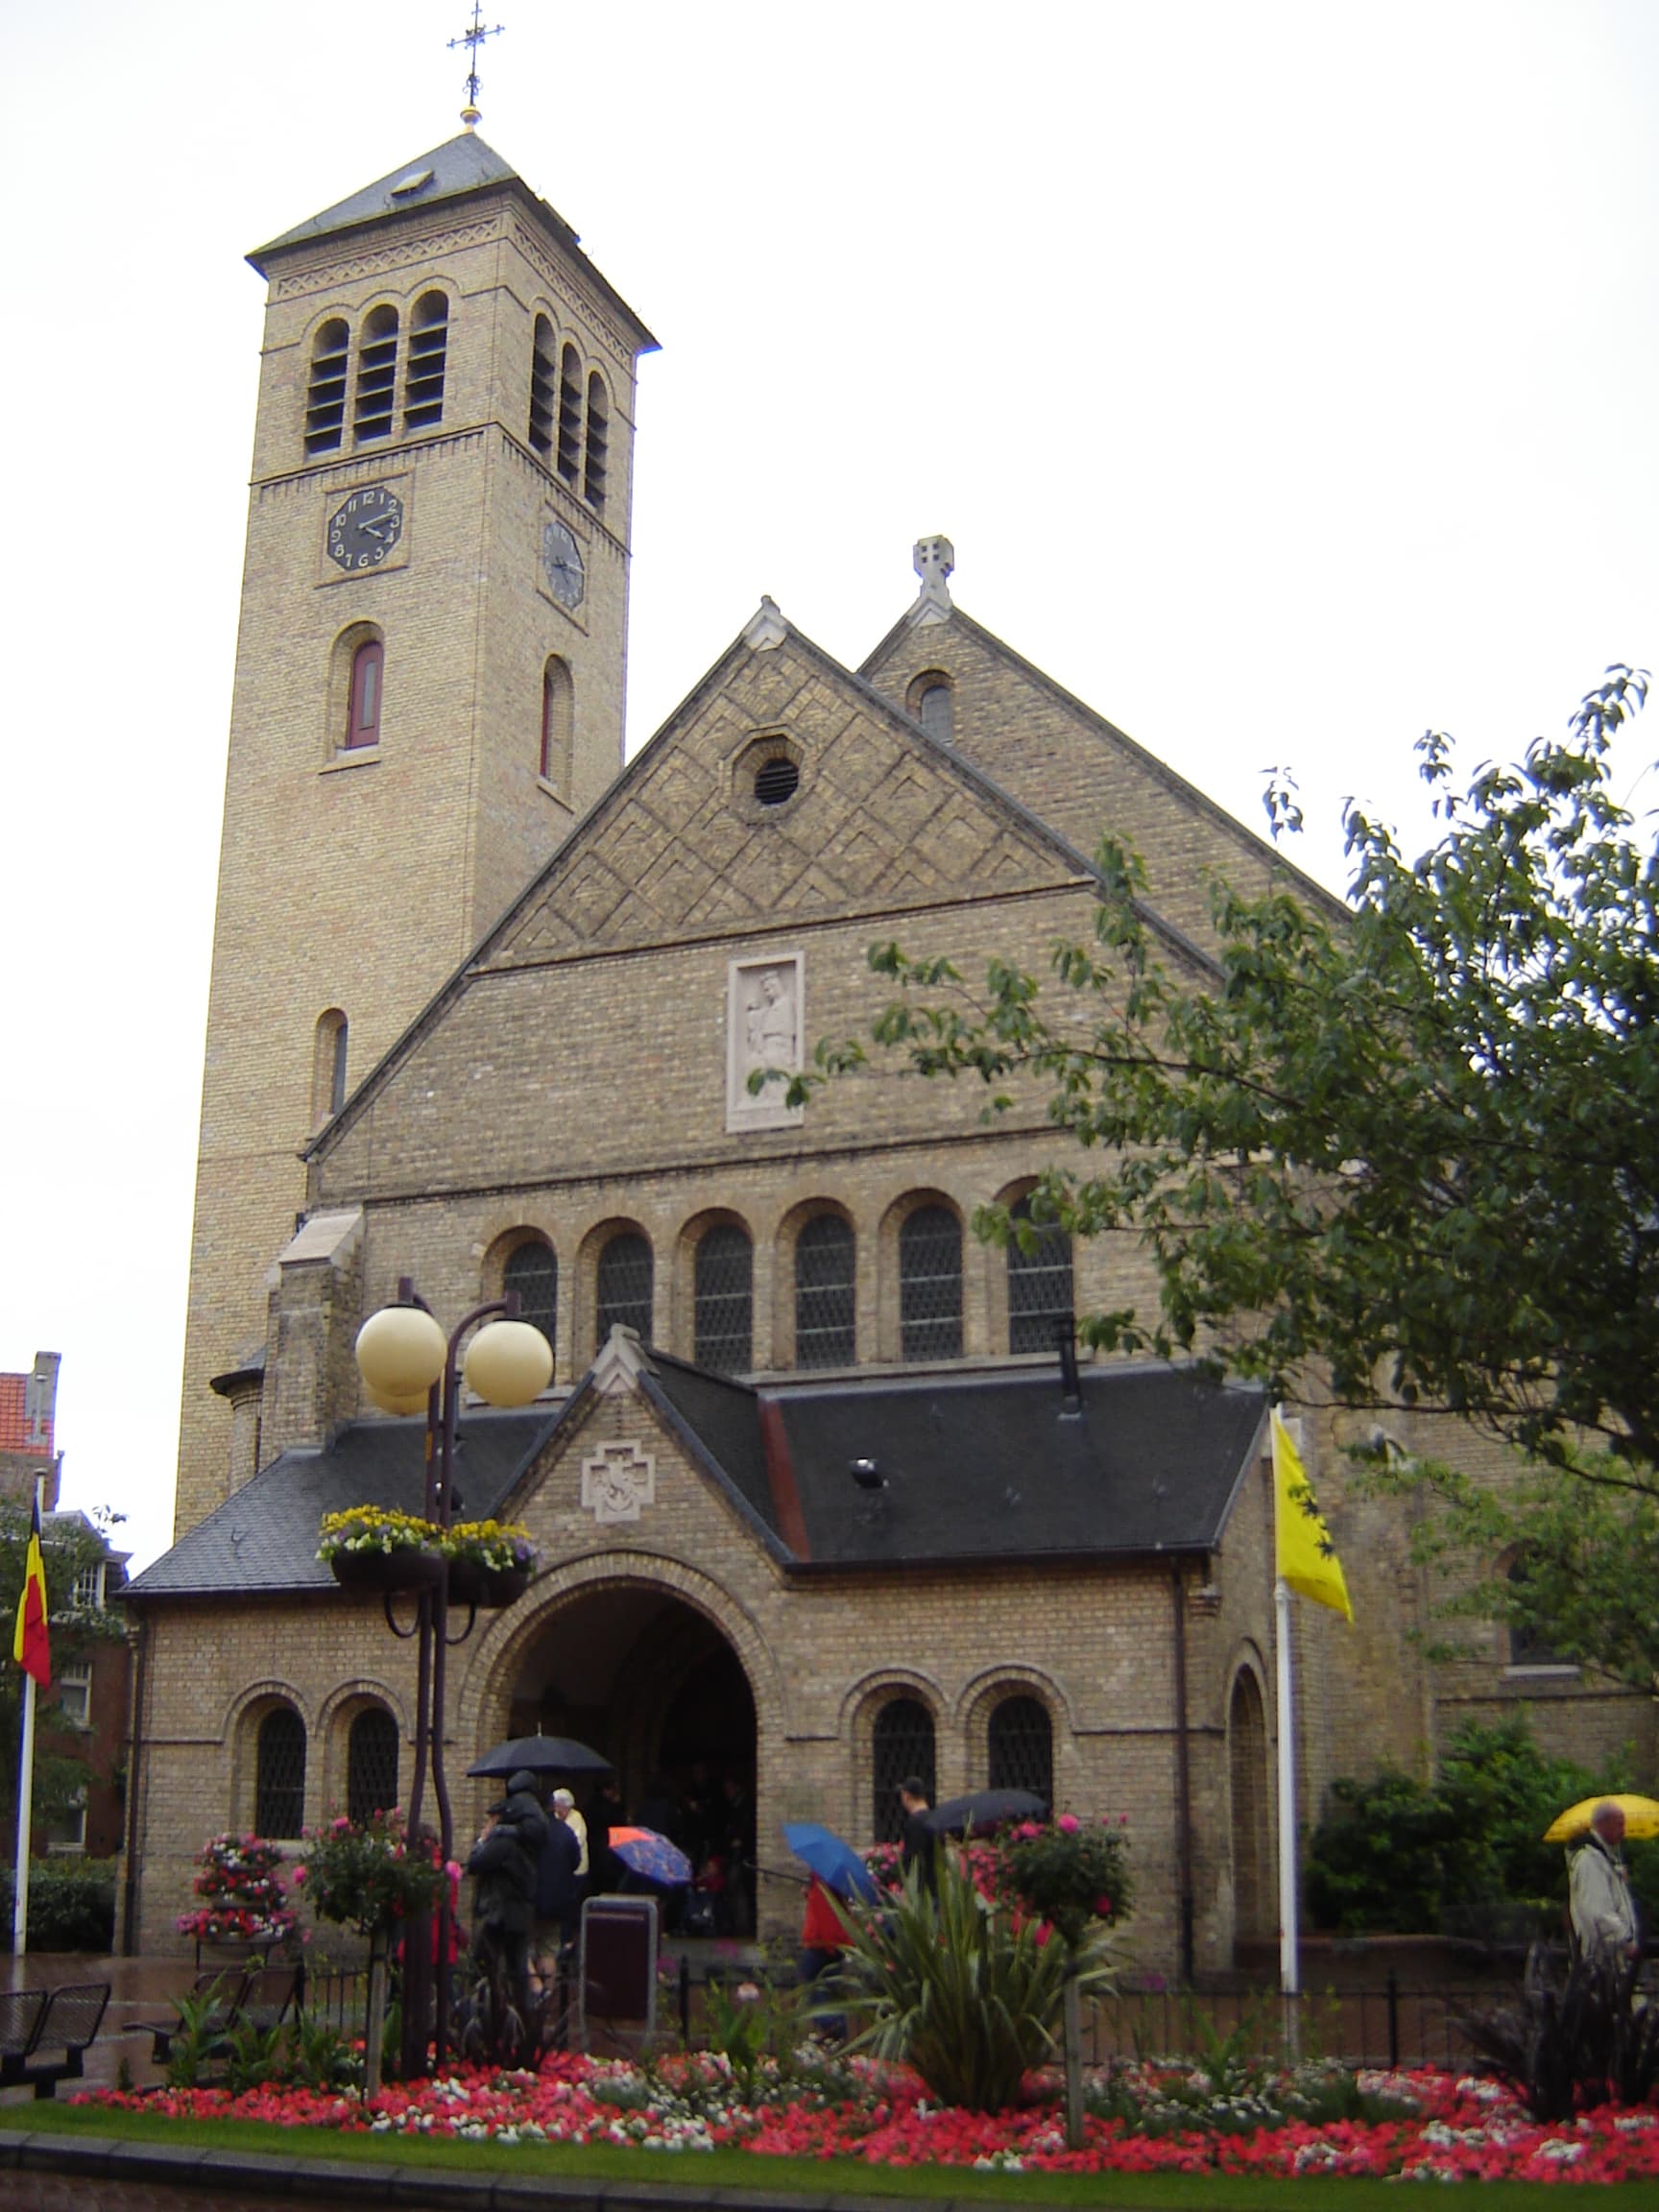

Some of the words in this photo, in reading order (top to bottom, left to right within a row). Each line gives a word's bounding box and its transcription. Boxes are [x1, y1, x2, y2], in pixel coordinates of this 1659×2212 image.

[363, 491, 374, 505] 12
[379, 493, 384, 504] 1
[349, 500, 357, 513] 11
[388, 499, 397, 512] 2
[335, 515, 346, 526] 10
[391, 516, 399, 528] 3
[331, 530, 341, 542] 9
[384, 532, 394, 543] 4
[334, 544, 345, 556] 8
[374, 547, 384, 560] 5
[346, 554, 352, 566] 7
[358, 553, 369, 566] 6
